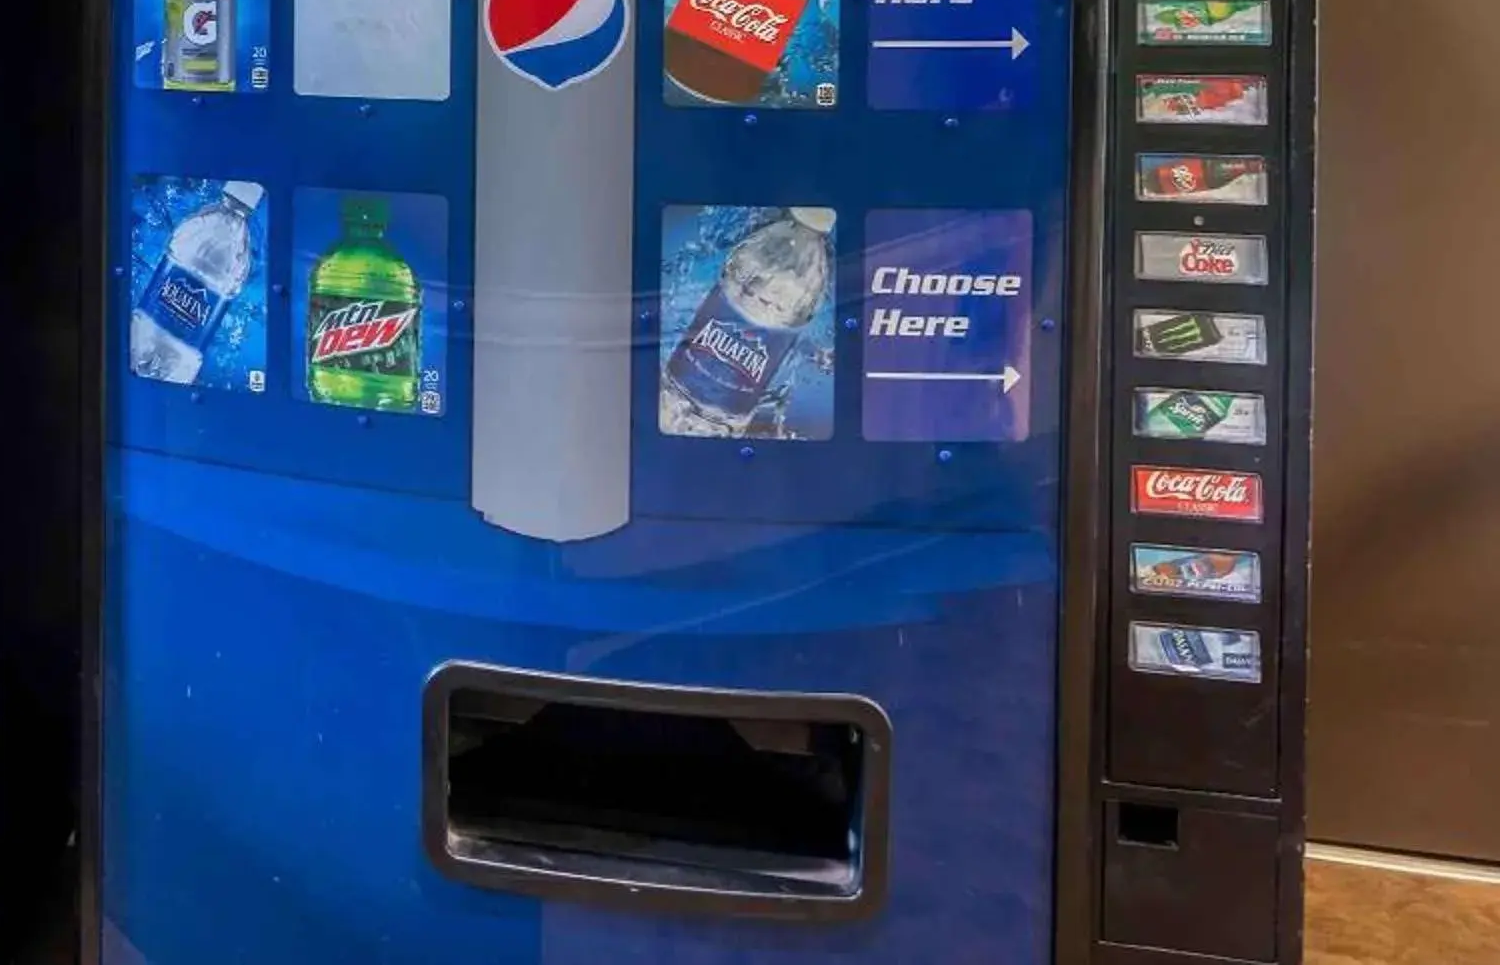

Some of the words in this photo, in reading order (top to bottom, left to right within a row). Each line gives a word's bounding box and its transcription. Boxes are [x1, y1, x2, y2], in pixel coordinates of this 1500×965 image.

[183, 0, 217, 46] G
[1182, 249, 1235, 274] Coke
[871, 266, 1022, 296] Choose
[869, 308, 970, 338] Here
[691, 321, 771, 385] AQUAFINA
[1146, 470, 1248, 503] Coca-Cola
